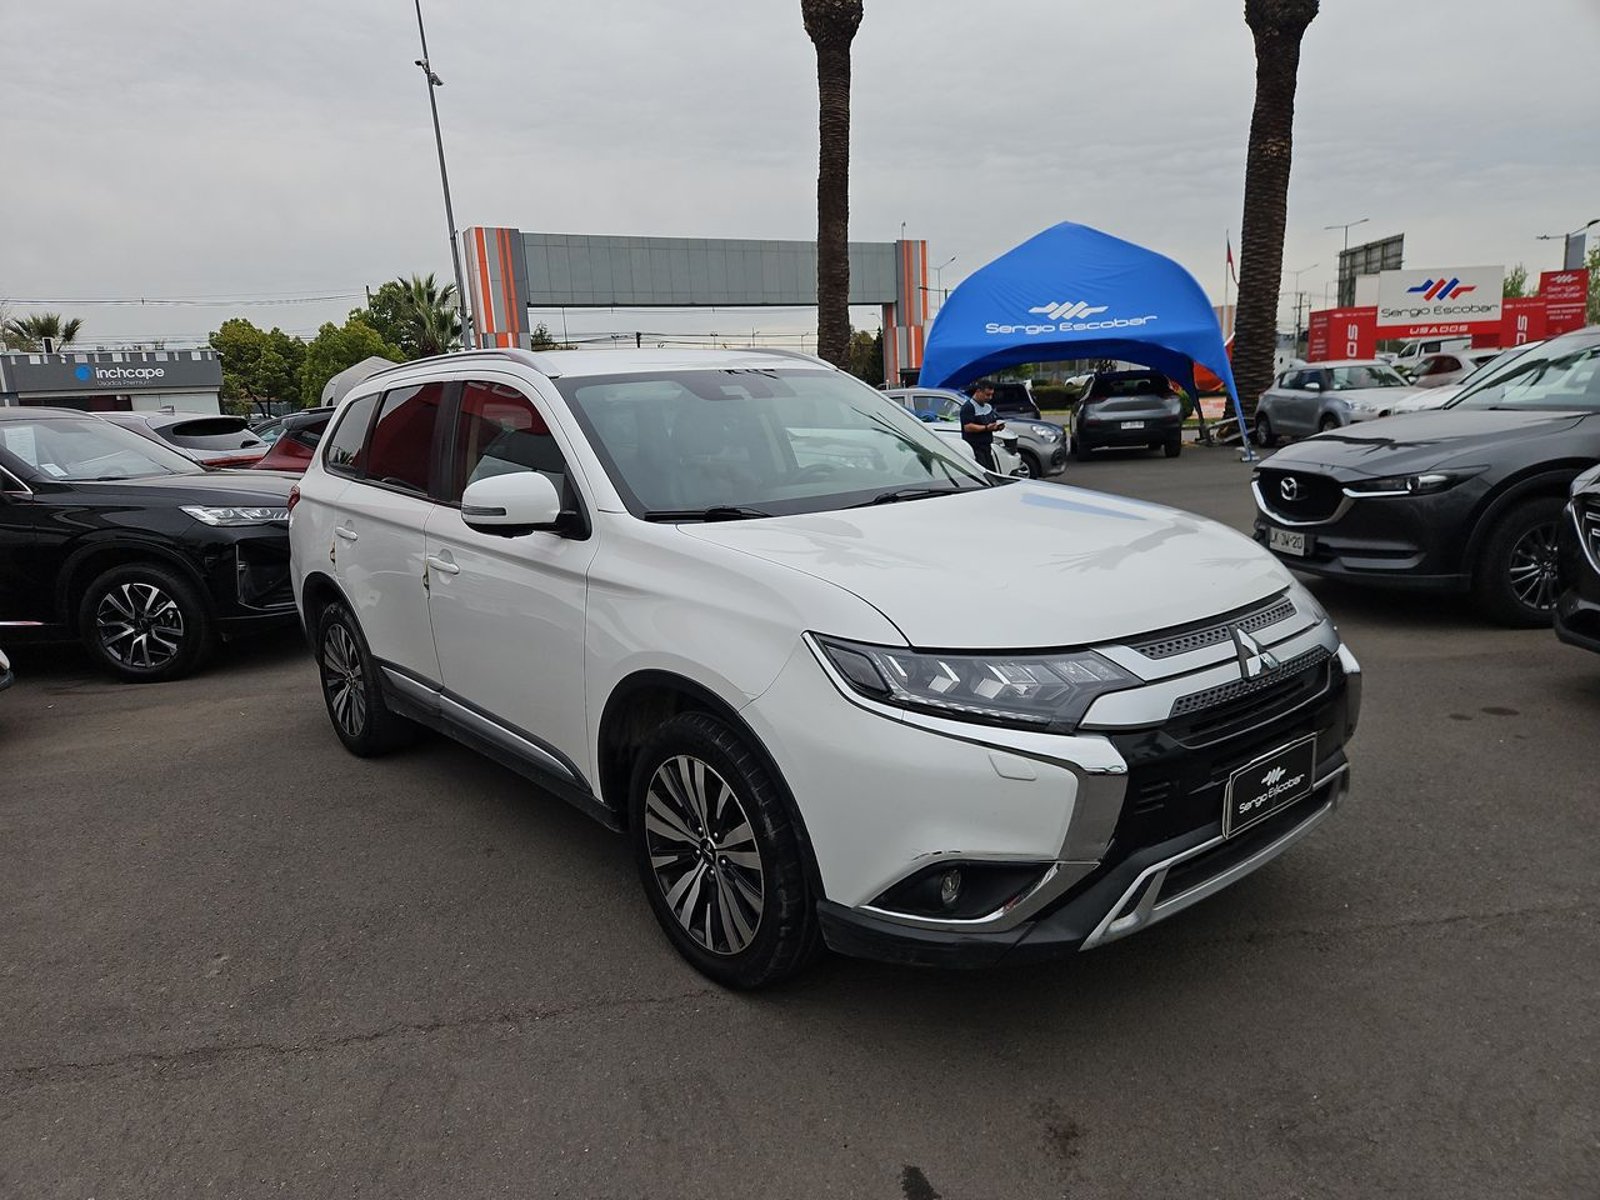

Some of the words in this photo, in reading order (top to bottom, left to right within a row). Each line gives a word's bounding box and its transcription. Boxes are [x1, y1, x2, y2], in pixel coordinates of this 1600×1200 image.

[1433, 299, 1499, 316] Escobar
[1059, 314, 1158, 332] Escobar
[1409, 324, 1469, 335] USADOS
[95, 366, 165, 379] inchcape
